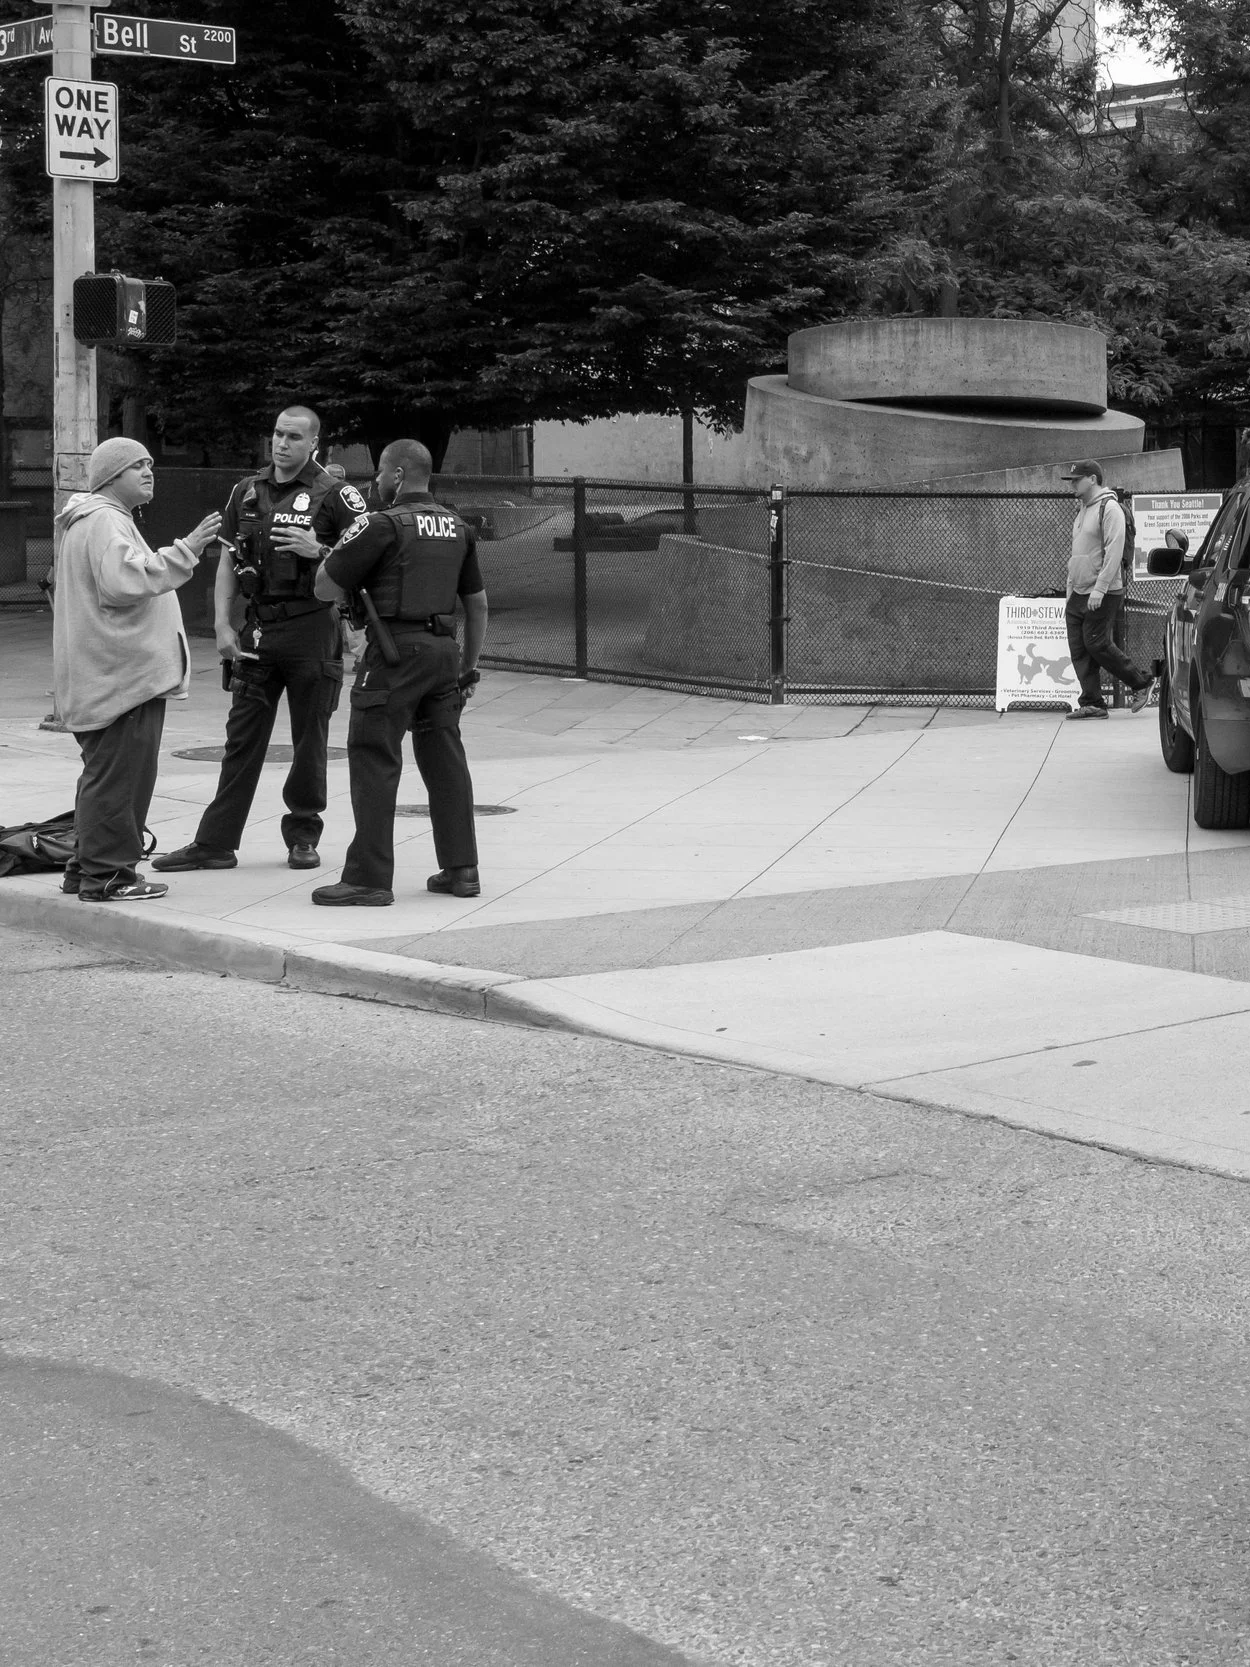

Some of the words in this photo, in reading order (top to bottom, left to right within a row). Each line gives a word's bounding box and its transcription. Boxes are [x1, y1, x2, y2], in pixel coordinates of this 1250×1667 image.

[103, 18, 148, 48] Bell
[180, 34, 197, 53] St
[204, 30, 232, 43] 2200
[55, 87, 109, 113] ONE
[55, 114, 111, 140] WAY
[1152, 500, 1168, 509] Thank
[1170, 500, 1180, 509] You
[1182, 499, 1204, 509] Seattle!
[273, 513, 312, 525] POLICE
[416, 515, 457, 538] POLICE
[1006, 607, 1031, 618] THIRD
